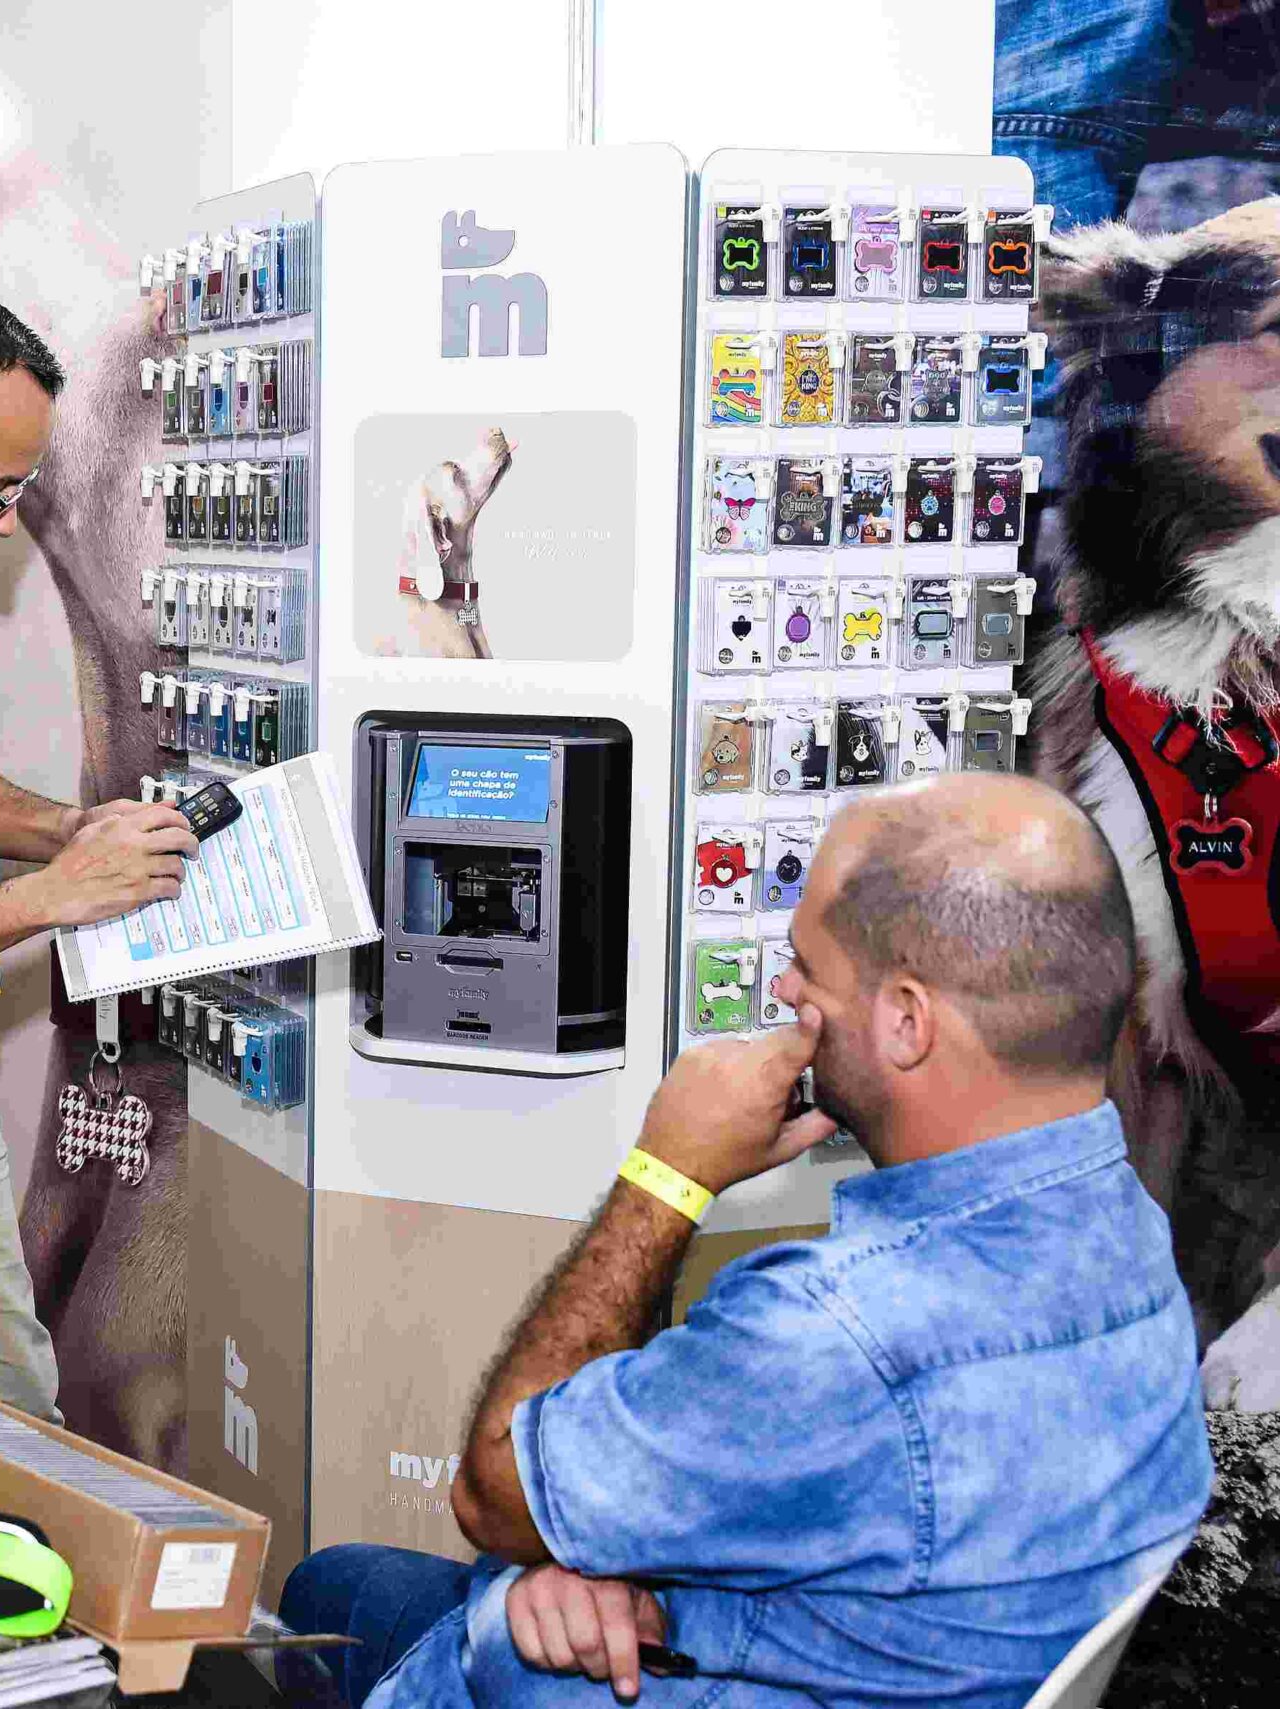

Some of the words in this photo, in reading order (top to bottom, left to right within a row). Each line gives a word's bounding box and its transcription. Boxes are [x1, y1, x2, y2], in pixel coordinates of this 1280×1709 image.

[500, 771, 520, 780] tem
[449, 780, 470, 788] uma
[472, 780, 501, 789] chapa
[503, 781, 517, 789] de
[1188, 841, 1233, 853] ALVIN
